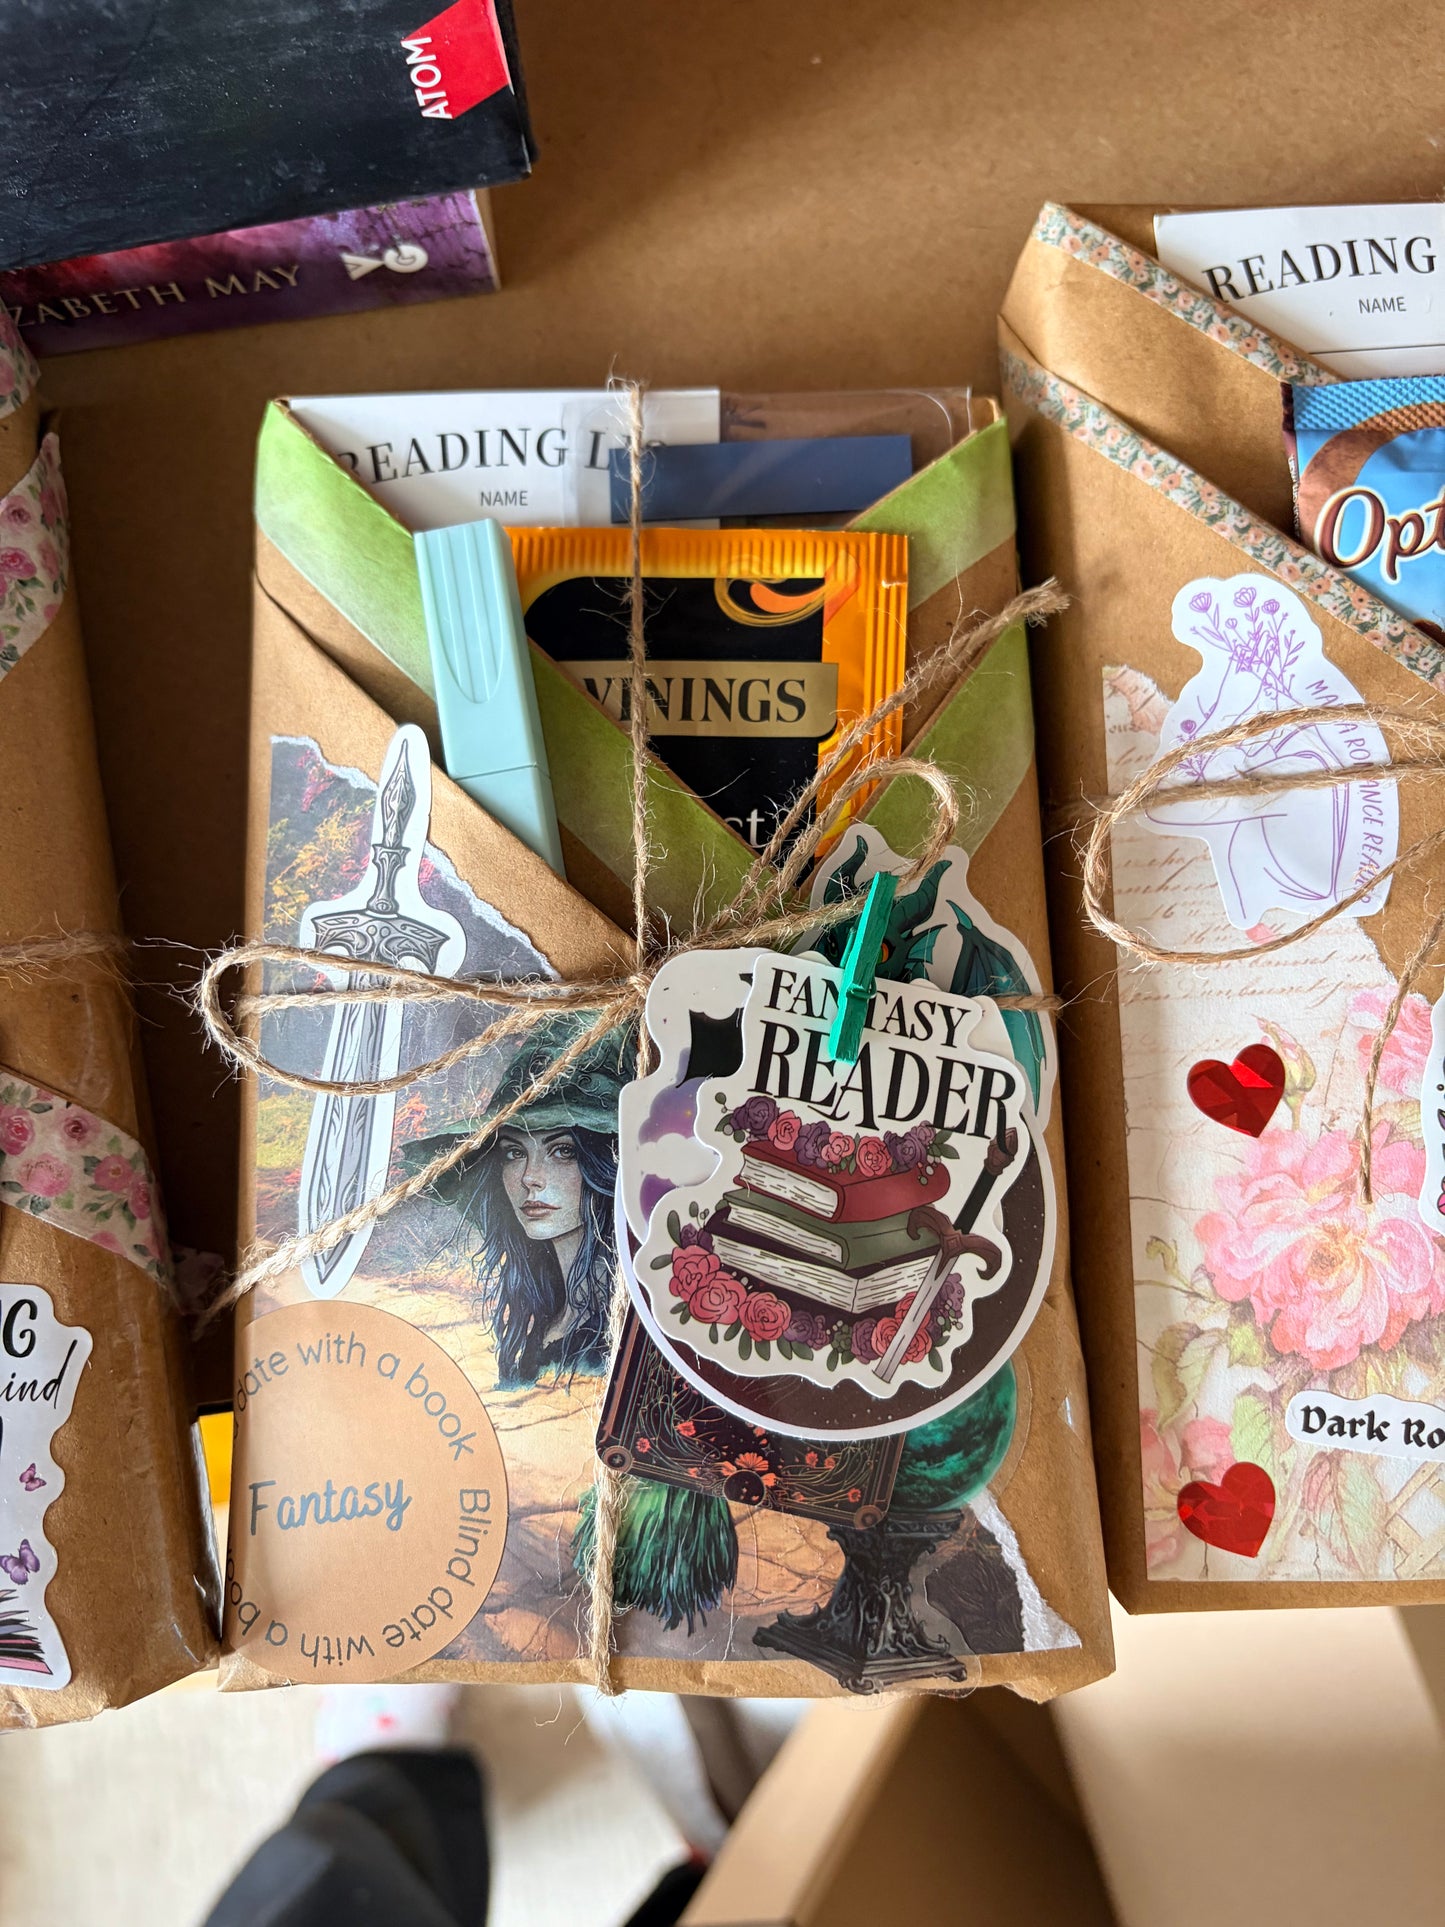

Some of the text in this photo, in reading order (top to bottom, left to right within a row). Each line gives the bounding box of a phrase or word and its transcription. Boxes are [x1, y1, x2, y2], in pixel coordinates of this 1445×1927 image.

[401, 37, 454, 119] ATOM
[205, 264, 300, 298] MAY
[1201, 236, 1437, 304] READING
[1358, 296, 1408, 315] NAME
[480, 490, 529, 507] NAME
[1344, 738, 1384, 827] ROANCE
[764, 967, 972, 1049] FANTASY
[747, 1019, 1017, 1153] READER
[0, 1339, 78, 1410] ind
[297, 1331, 366, 1367] with
[377, 1352, 401, 1380] a
[404, 1363, 477, 1461] book
[1300, 1404, 1391, 1442] Dark
[248, 1478, 413, 1536] Fantasy
[227, 1488, 492, 1668] Blind date with a boo
